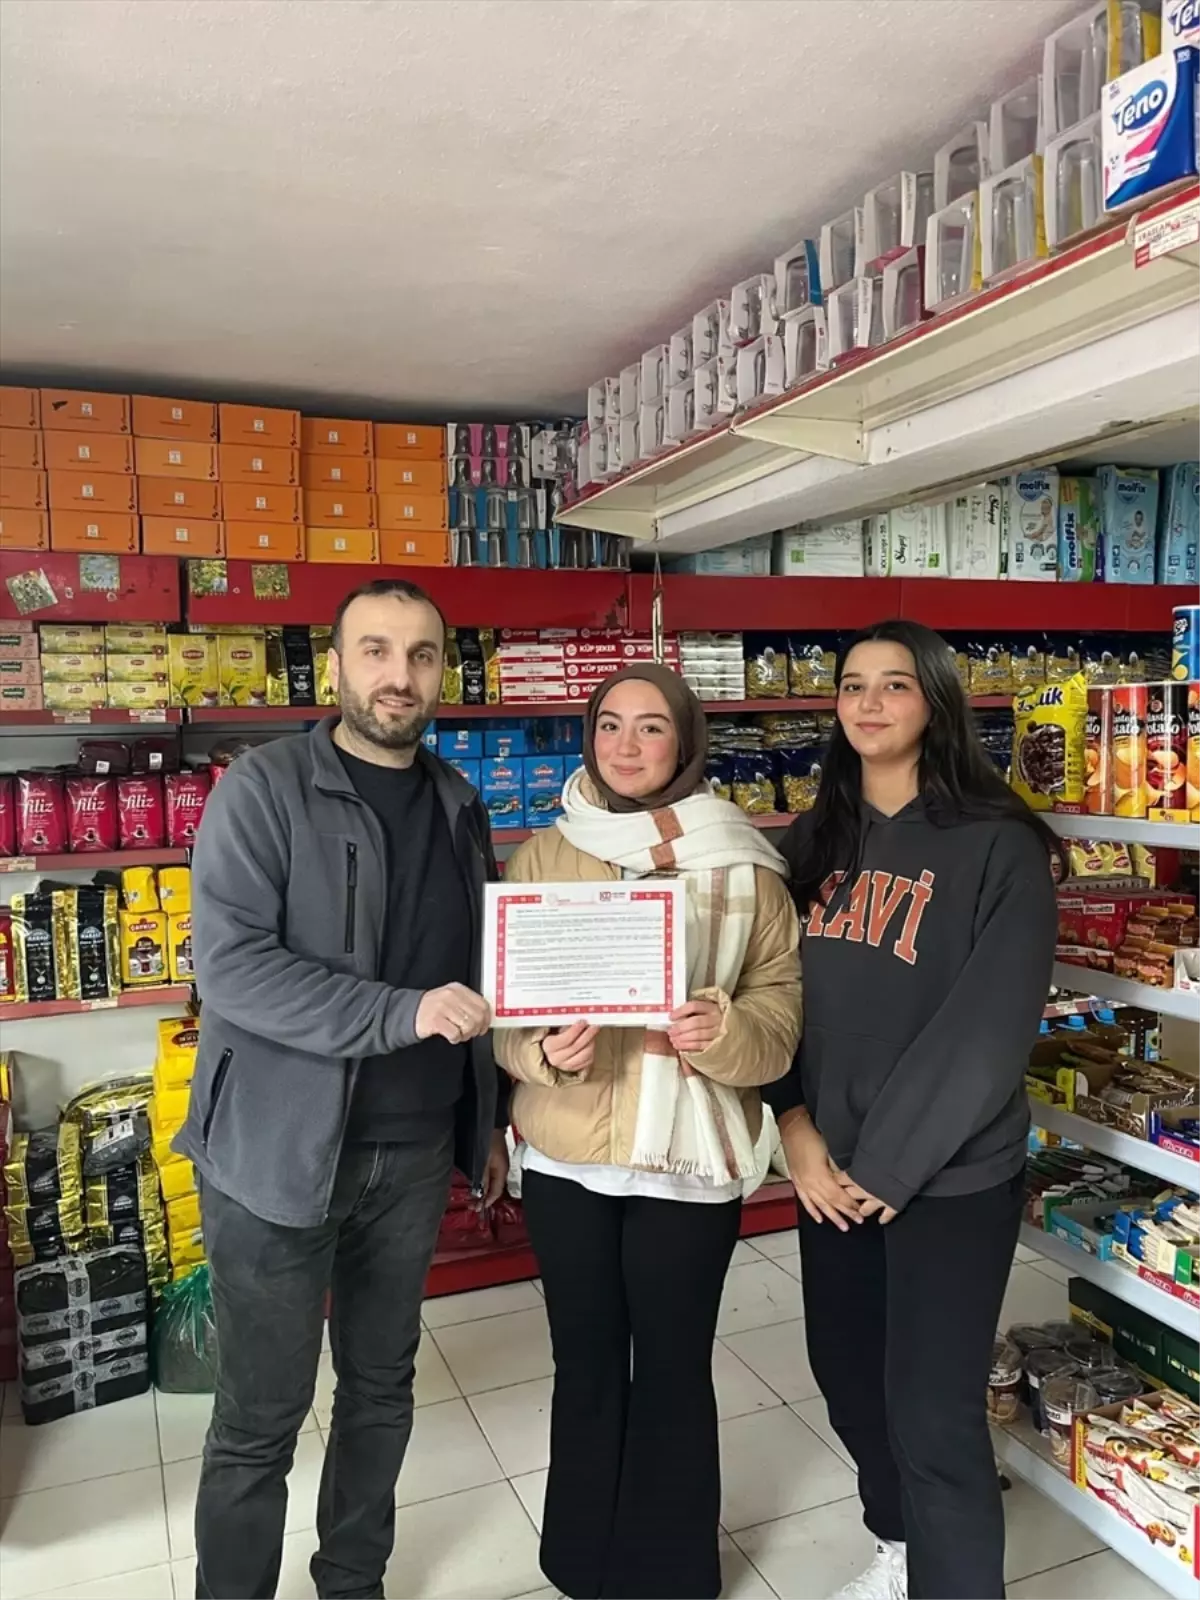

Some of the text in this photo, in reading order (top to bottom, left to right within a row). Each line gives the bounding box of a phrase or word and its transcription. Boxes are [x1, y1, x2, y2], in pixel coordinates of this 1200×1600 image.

[1114, 87, 1164, 136] Teno
[1019, 481, 1050, 491] molfix
[1118, 481, 1147, 494] molfix
[1065, 512, 1077, 569] molfix
[579, 642, 616, 654] KÜP ŞEKER
[581, 664, 618, 674] KÜP ŞEKER
[72, 796, 106, 815] filiz
[122, 793, 155, 812] filiz
[173, 792, 204, 811] filiz
